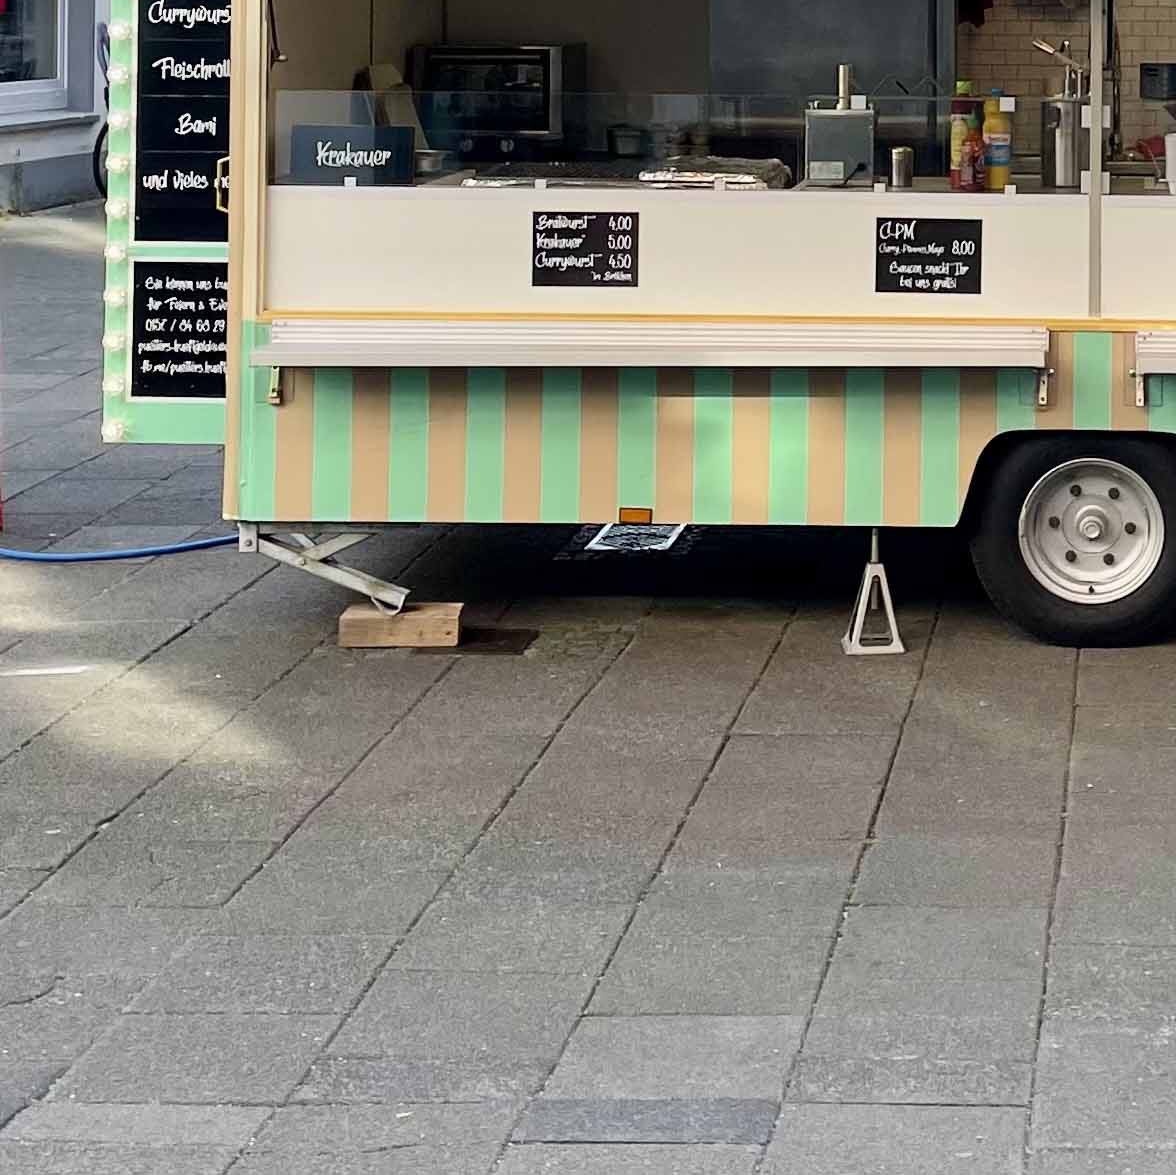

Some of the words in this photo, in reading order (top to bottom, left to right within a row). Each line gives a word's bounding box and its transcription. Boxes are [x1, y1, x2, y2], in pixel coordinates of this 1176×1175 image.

[174, 112, 217, 136] Bami
[315, 140, 392, 168] Krakauer
[142, 169, 169, 191] und
[535, 214, 597, 230] Bratwurst
[536, 232, 584, 249] Krakauer
[535, 251, 603, 271] Currywurst
[196, 280, 213, 291] uns
[914, 278, 930, 289] uns
